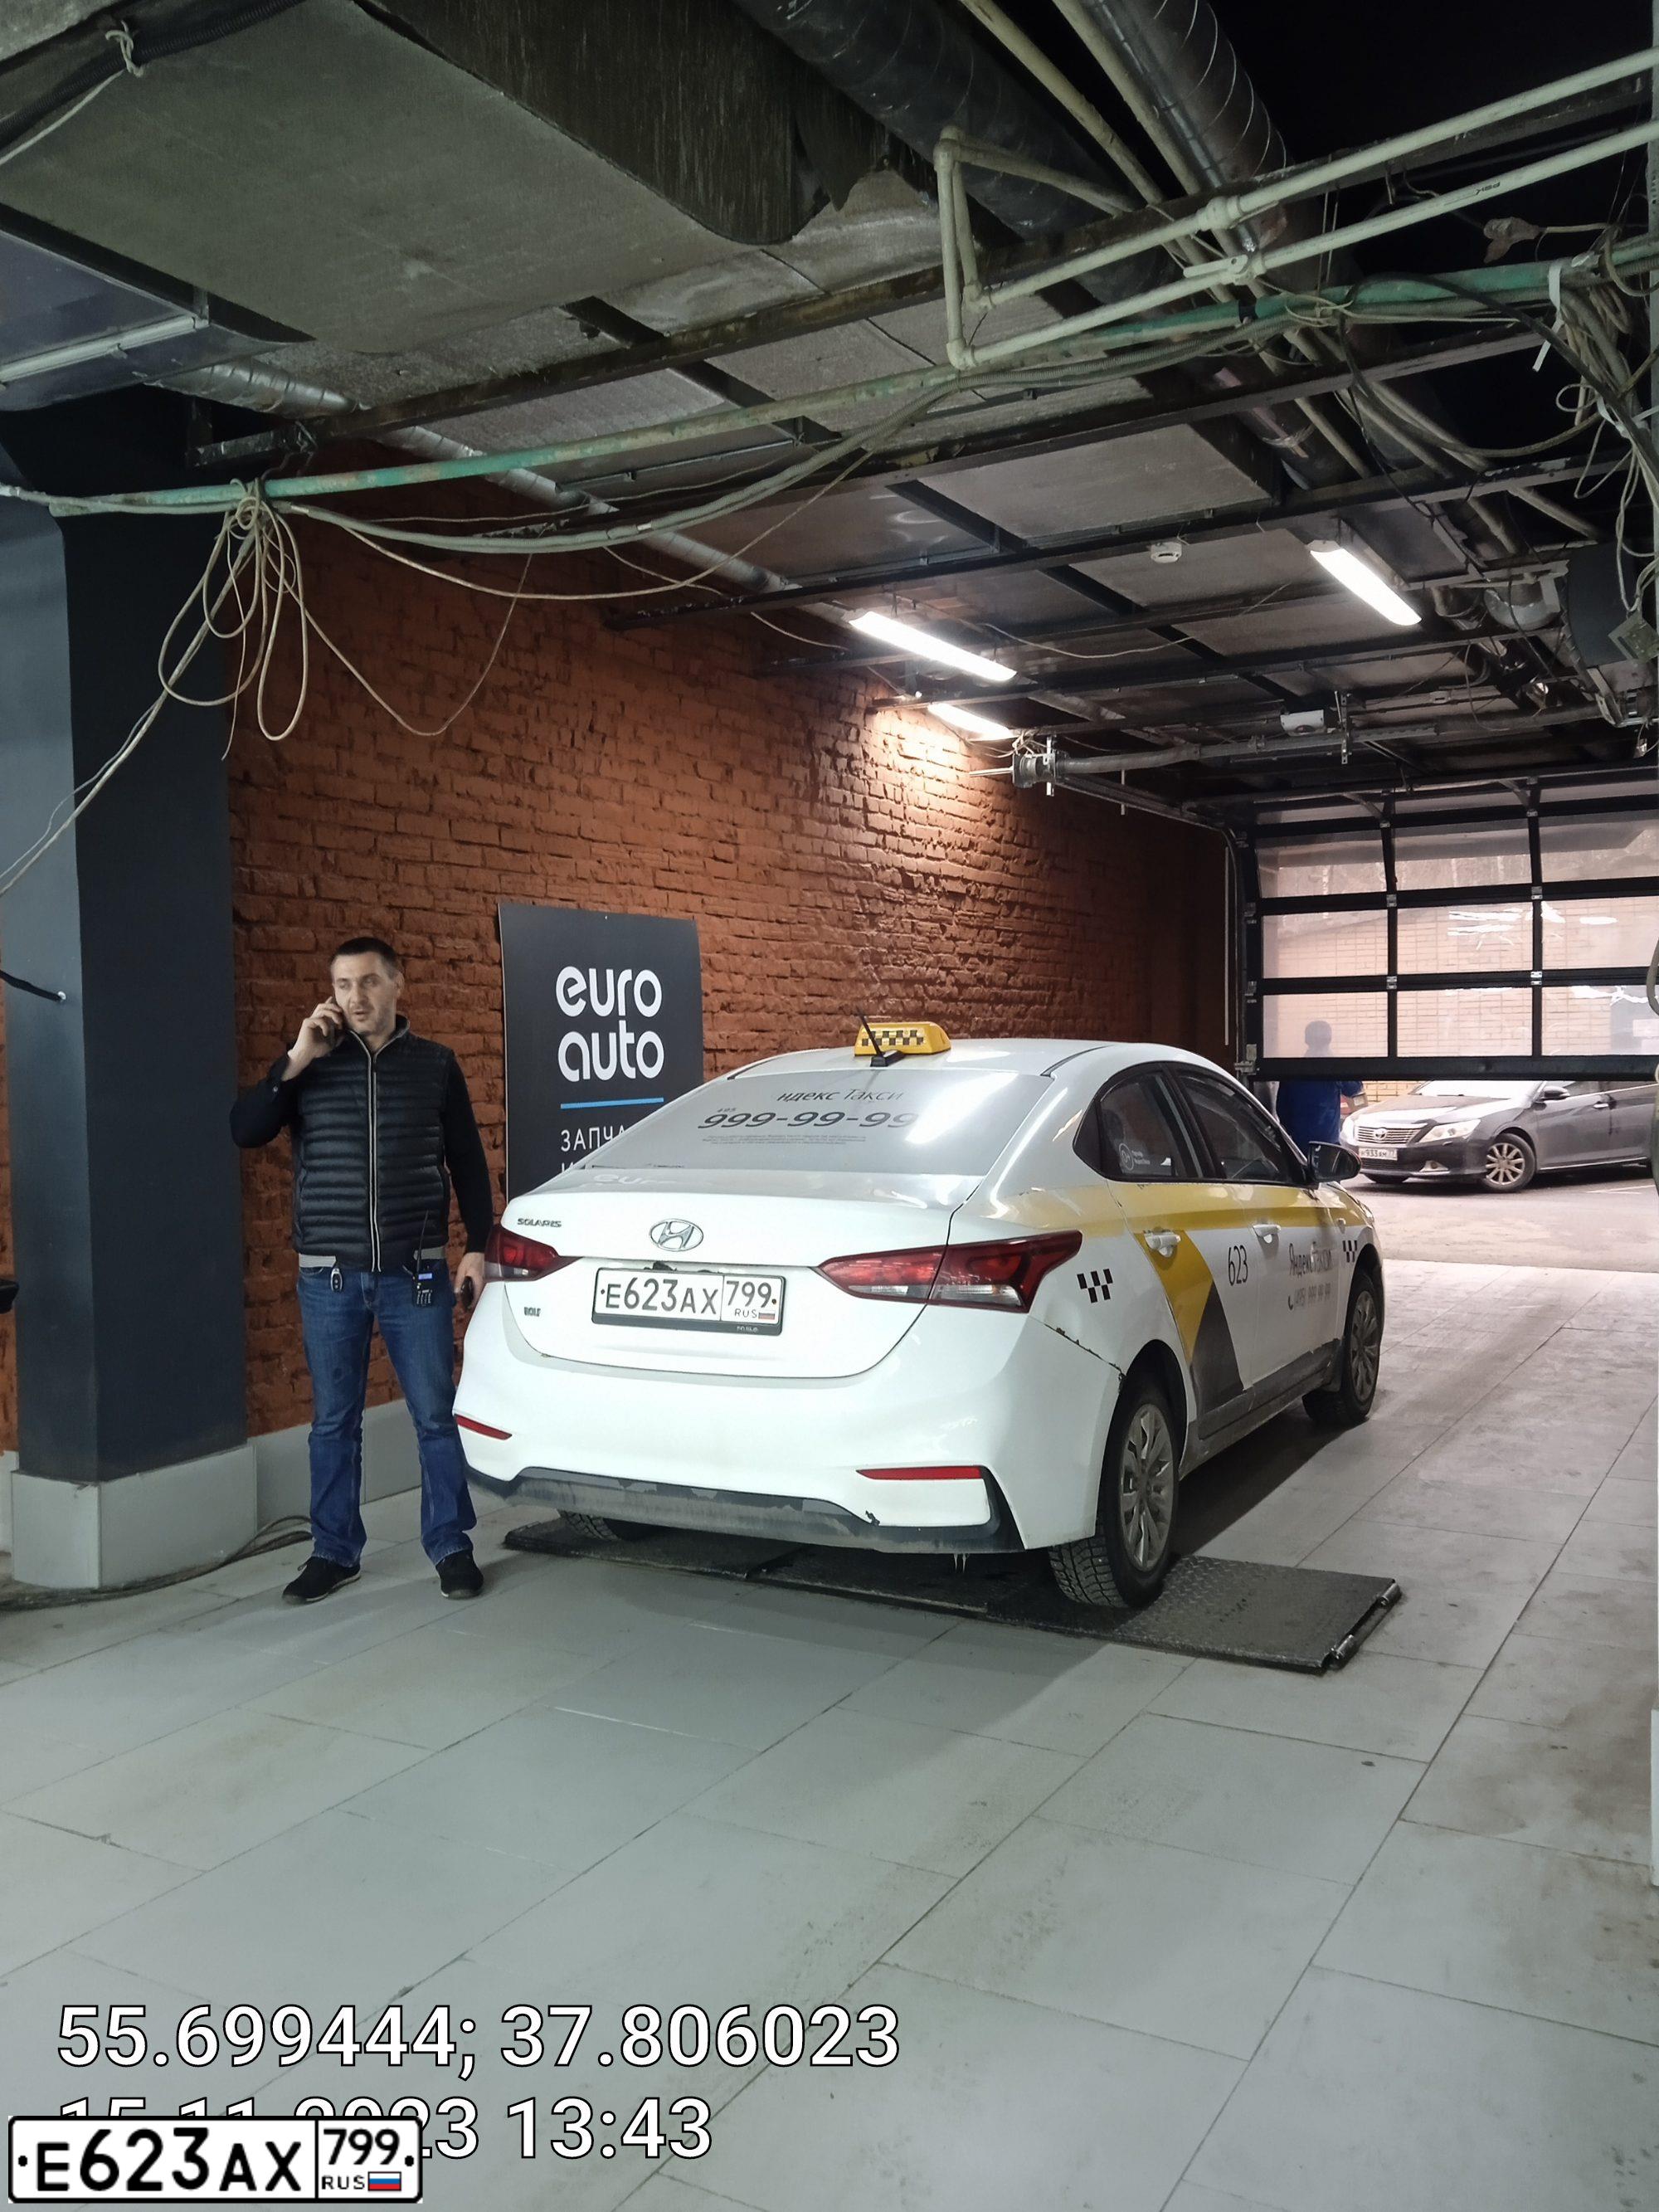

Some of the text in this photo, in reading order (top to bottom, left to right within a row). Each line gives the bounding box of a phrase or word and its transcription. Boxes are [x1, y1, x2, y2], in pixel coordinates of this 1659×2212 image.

[555, 966, 663, 1017] euro
[557, 1020, 664, 1082] auto
[772, 1088, 905, 1103] ндекс Такси
[698, 1111, 919, 1129] 999-99-99
[517, 1218, 562, 1228] SOLARIS
[1228, 1245, 1248, 1286] 623
[606, 1277, 772, 1315] Е623АХ 799
[734, 1309, 757, 1318] RUS
